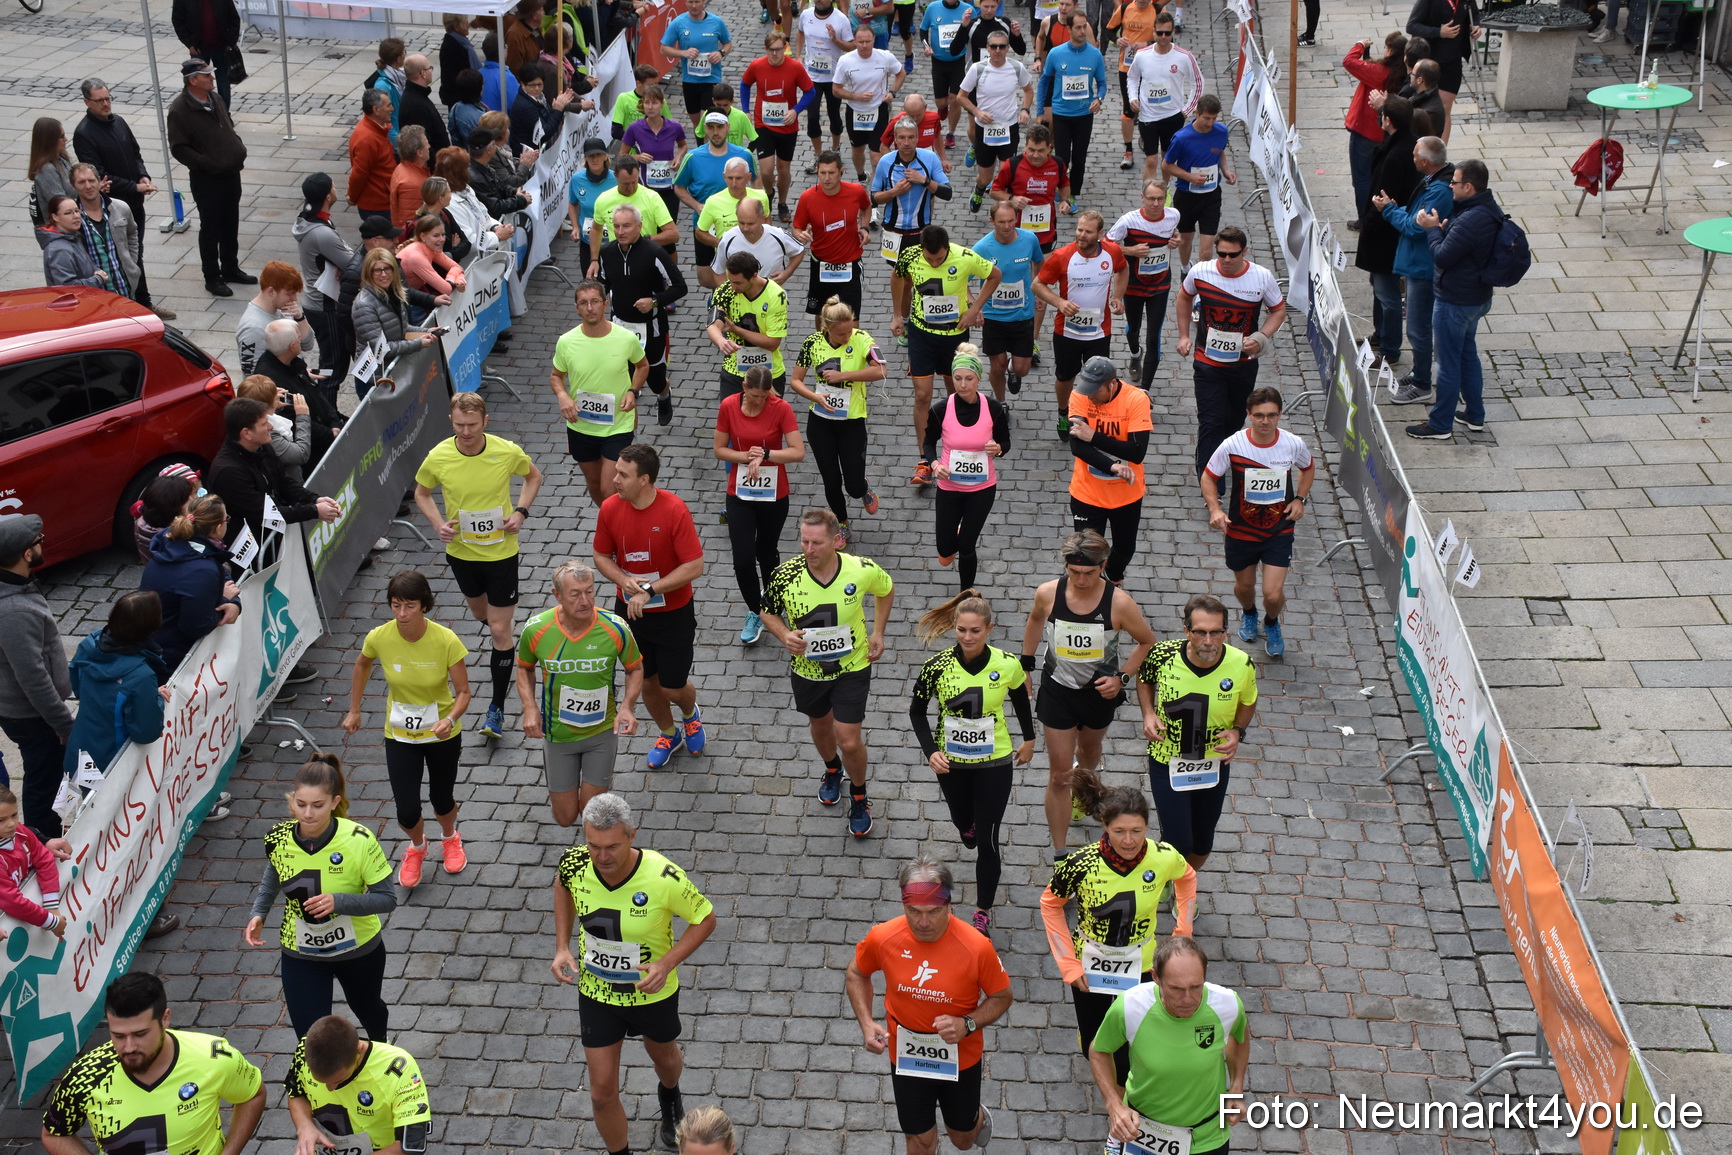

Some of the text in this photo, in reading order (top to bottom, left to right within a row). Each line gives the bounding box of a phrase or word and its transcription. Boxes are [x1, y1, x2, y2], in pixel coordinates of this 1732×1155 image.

[690, 60, 708, 68] 2747
[811, 59, 828, 70] 2175
[1066, 82, 1085, 91] 2425
[1149, 89, 1168, 98] 2795
[857, 113, 875, 122] 2577
[987, 128, 1006, 136] 2768
[650, 168, 670, 178] 2336
[1028, 213, 1044, 222] 115
[1143, 253, 1166, 265] 2779
[824, 263, 847, 271] 2062
[996, 290, 1020, 299] 2100
[928, 303, 954, 314] 2682
[1069, 315, 1093, 326] 2241
[1211, 339, 1236, 351] 2783
[741, 354, 767, 364] 2685
[357, 359, 371, 376] swn
[581, 400, 609, 413] 2384
[954, 461, 983, 474] 2596
[741, 476, 771, 489] 2012
[1250, 478, 1281, 491] 2784
[470, 520, 494, 532] 163
[236, 540, 251, 562] swn
[1463, 559, 1476, 581] swn
[810, 637, 845, 653] 2663
[1066, 634, 1092, 648] 103
[1066, 649, 1092, 657] Sebastian
[544, 657, 609, 674] BOCK
[566, 698, 600, 713] 2748
[405, 716, 423, 730] 87
[951, 729, 987, 744] 2684
[1177, 760, 1213, 773] 2679
[116, 893, 160, 974] Service-Line:
[304, 927, 345, 947] 2660
[1549, 926, 1572, 974] Neumarkts
[591, 949, 631, 971] 2675
[1090, 956, 1133, 974] 2677
[600, 970, 622, 978] Werner
[1102, 977, 1119, 985] Karin
[898, 983, 945, 998] funrunners
[911, 993, 953, 1004] neumarkt
[906, 1042, 949, 1060] 2490
[914, 1060, 941, 1070] Hartmut
[1135, 1128, 1180, 1155] 2276
